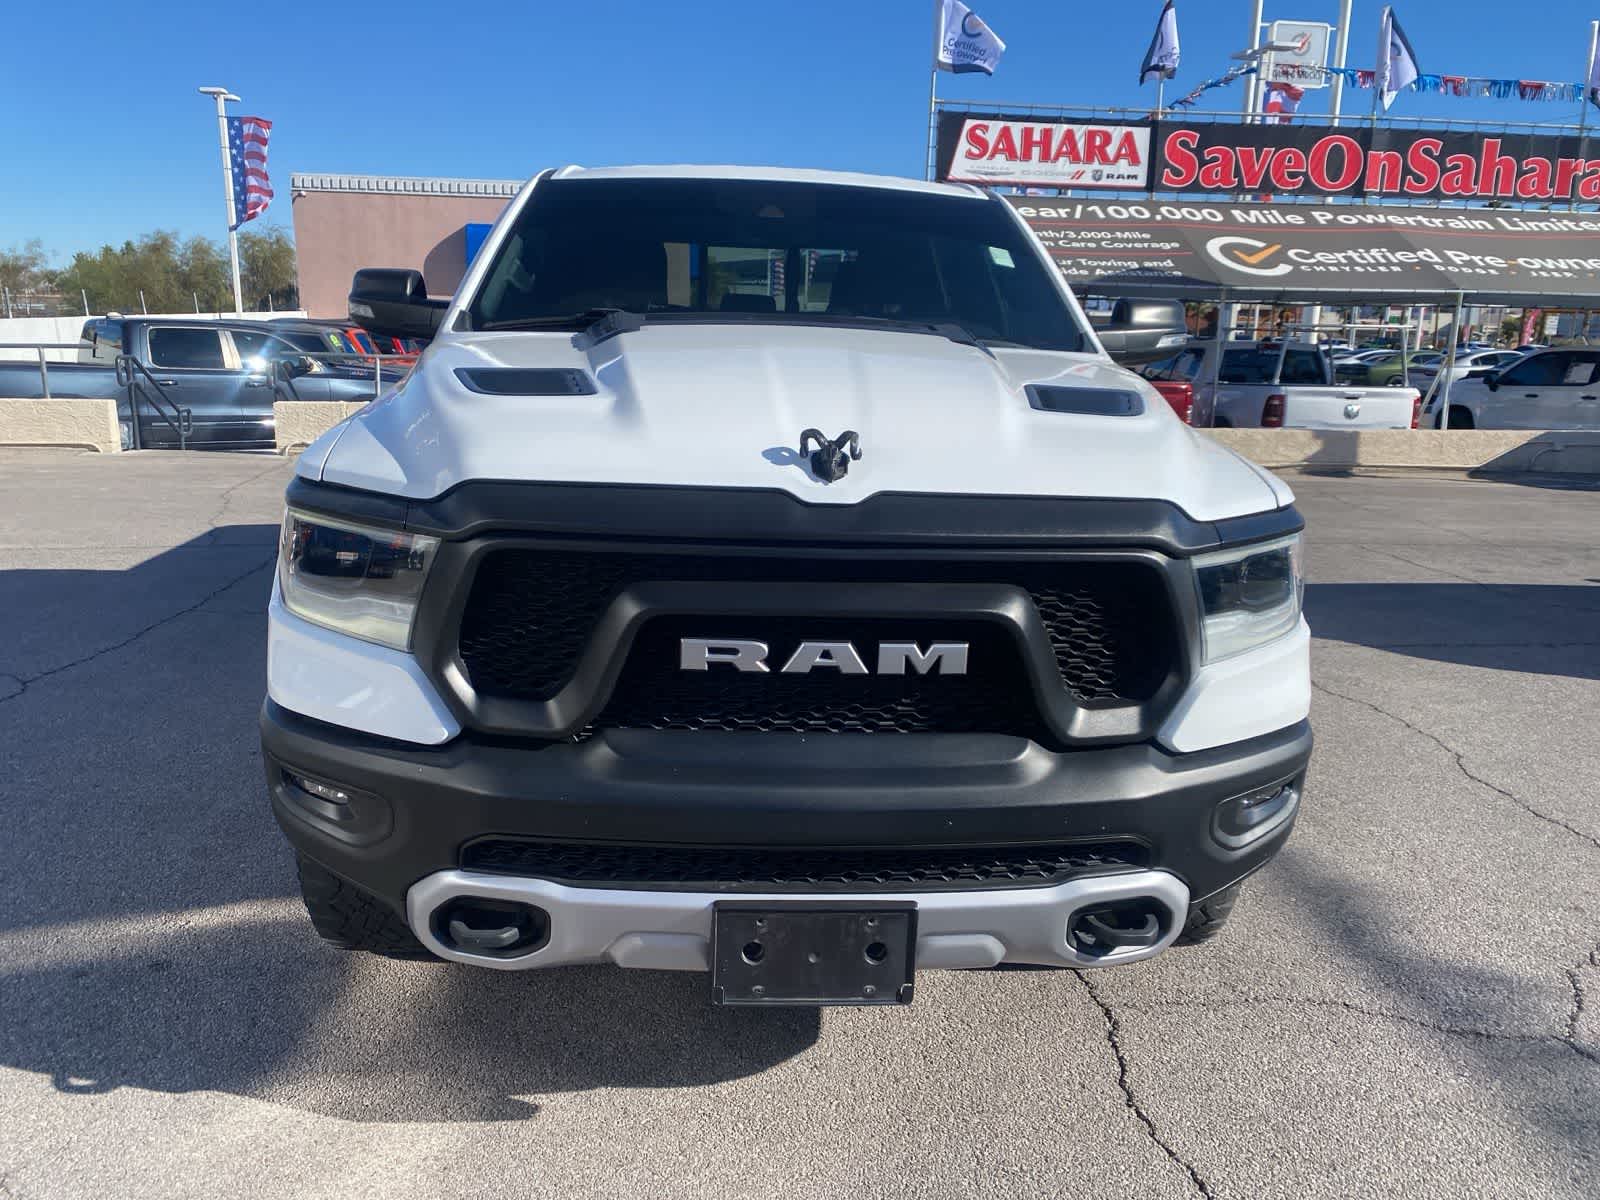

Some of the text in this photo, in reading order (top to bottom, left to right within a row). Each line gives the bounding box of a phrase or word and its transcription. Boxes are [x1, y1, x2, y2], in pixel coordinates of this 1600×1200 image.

[964, 123, 1142, 166] SAHARA
[1162, 128, 1600, 200] SaveOnSahara
[1106, 173, 1139, 181] RAM
[1230, 209, 1306, 225] Mile
[1311, 211, 1495, 231] Powertrain
[1496, 217, 1600, 231] Limite
[1058, 240, 1097, 248] Care
[1101, 240, 1180, 250] Coverage
[1076, 258, 1139, 269] Towing
[1143, 259, 1175, 267] and
[1288, 248, 1440, 265] Certified
[1433, 264, 1501, 275] DODGE
[680, 638, 969, 675] RAM
